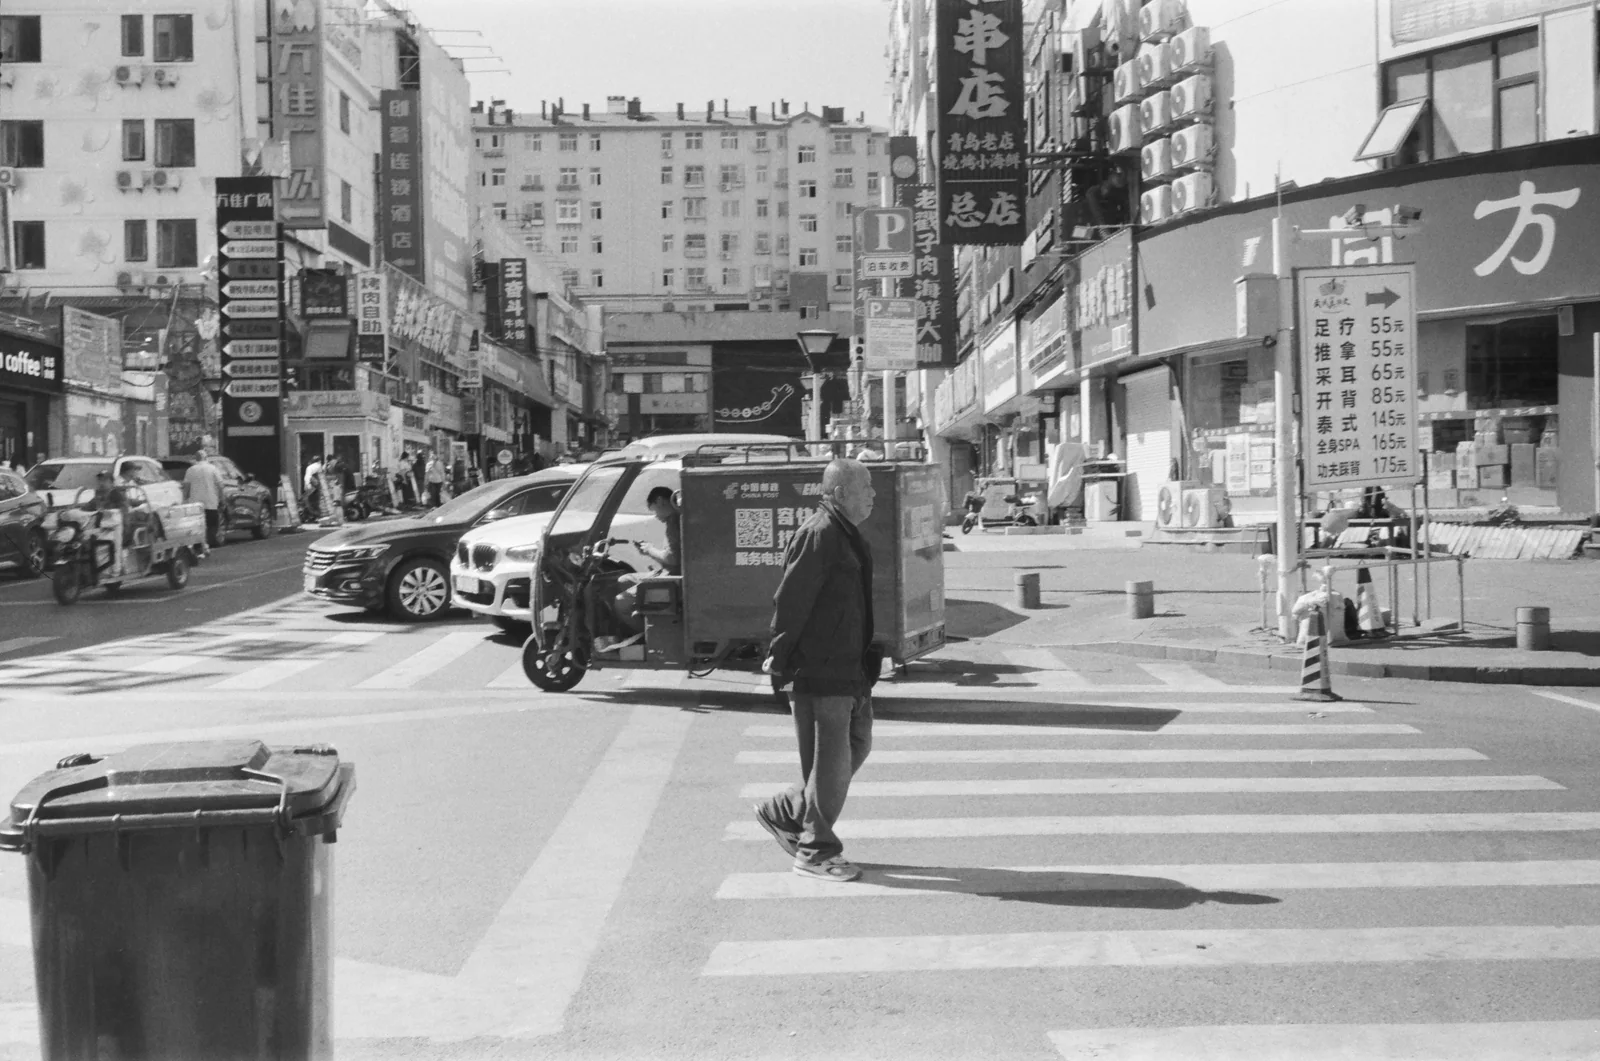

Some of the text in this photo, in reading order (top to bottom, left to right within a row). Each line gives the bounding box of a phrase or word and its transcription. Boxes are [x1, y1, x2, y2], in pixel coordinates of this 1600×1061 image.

[216, 193, 272, 208] 万佳广场
[944, 191, 1021, 228] 总店
[875, 213, 905, 250] P
[867, 261, 909, 272] 泊车收费
[361, 277, 382, 333] 烤肉自助
[870, 302, 882, 318] P
[1314, 316, 1404, 337] 足疗 55元
[1314, 340, 1405, 362] 推拿 55元
[5, 350, 40, 377] coffee
[1371, 363, 1405, 381] 65元
[1316, 387, 1406, 410] 开背 85元
[1317, 413, 1358, 434] 泰式
[1372, 410, 1406, 428] 145元
[740, 482, 779, 492] 中国邮政
